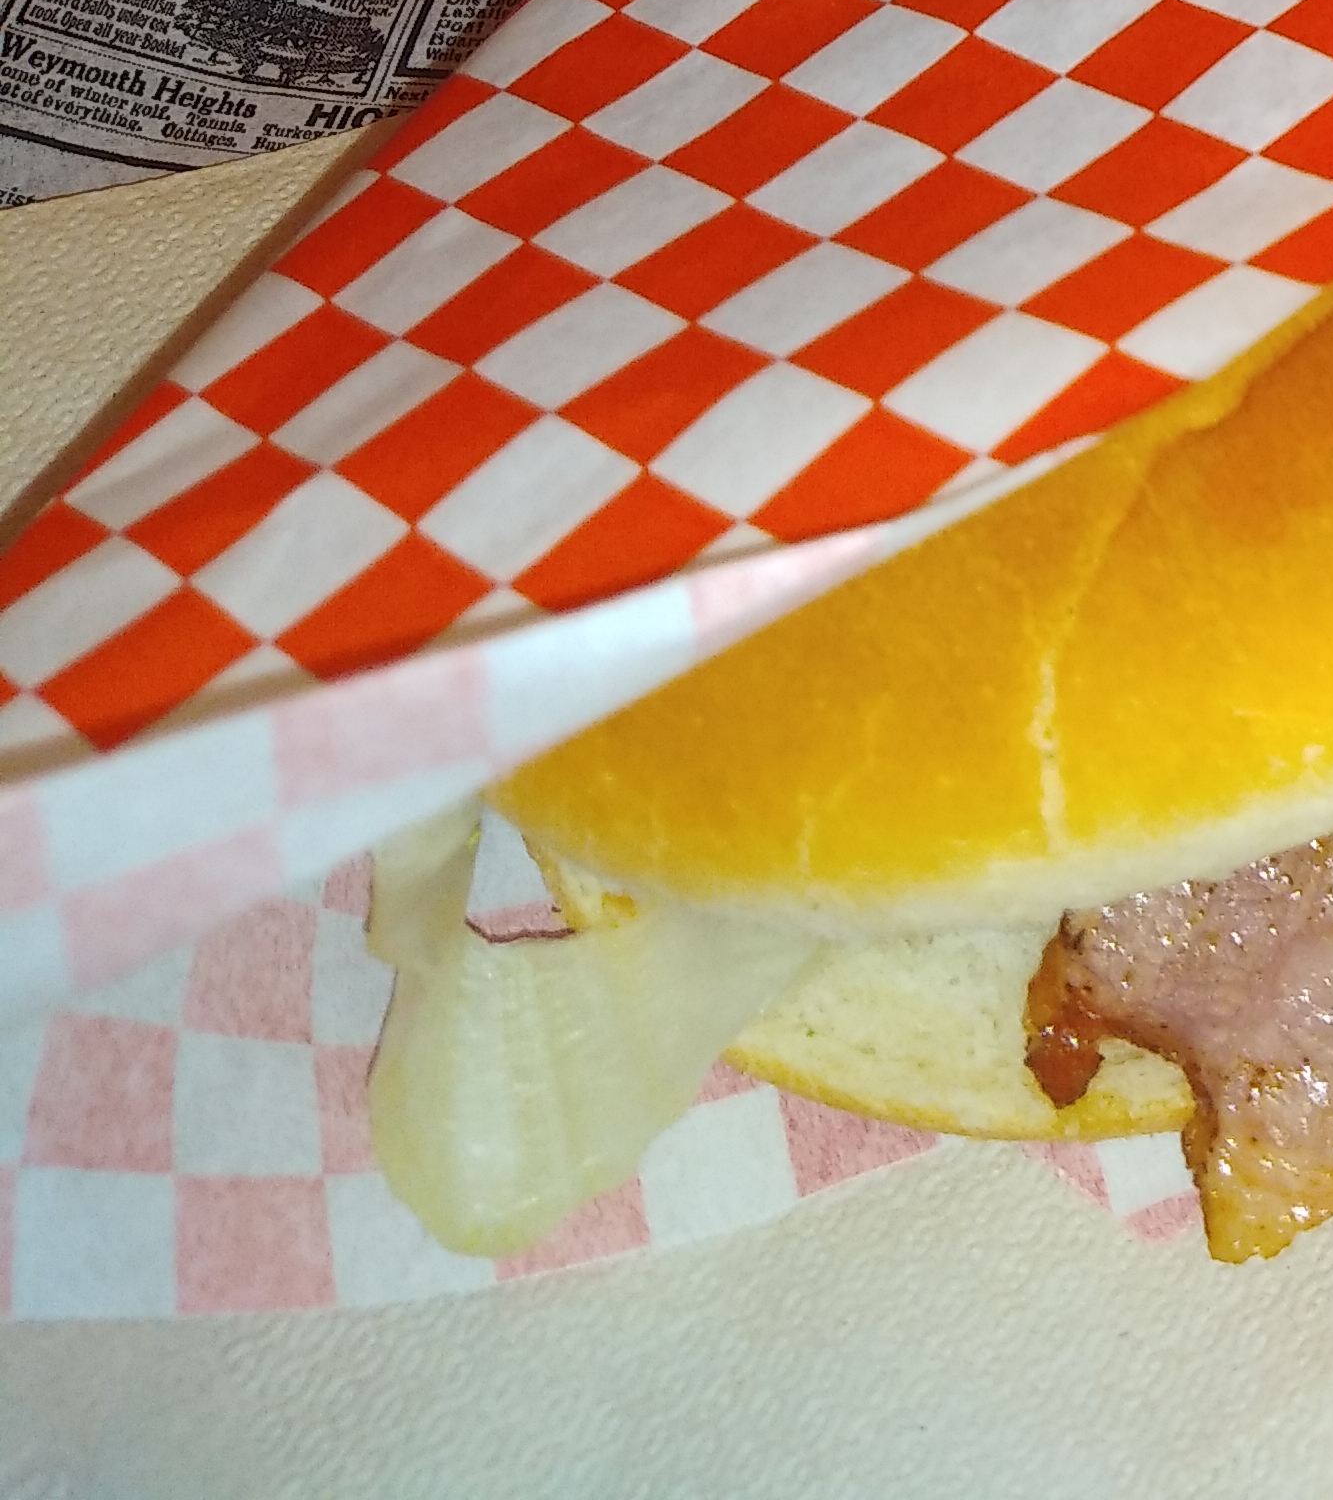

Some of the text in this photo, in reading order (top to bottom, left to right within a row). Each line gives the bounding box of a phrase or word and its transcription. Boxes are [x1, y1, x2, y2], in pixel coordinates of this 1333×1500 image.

[60, 10, 114, 39] Open all
[1, 30, 257, 119] Weymouth Heights
[20, 86, 143, 132] of everything.
[44, 77, 247, 134] of winter golf. Tennis.
